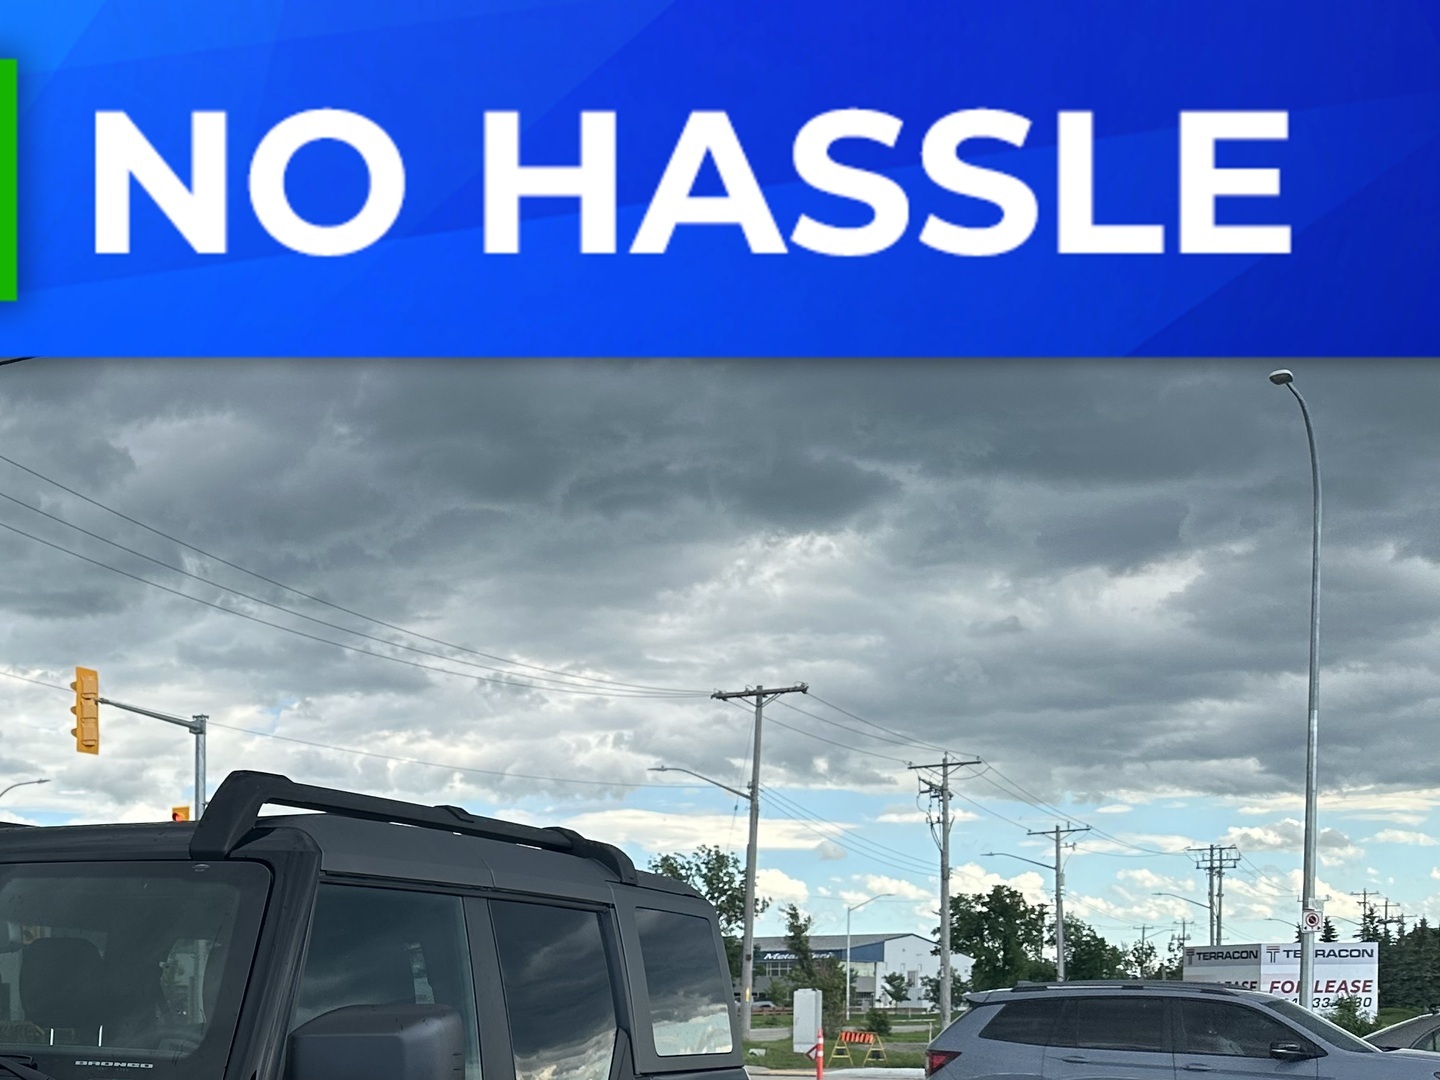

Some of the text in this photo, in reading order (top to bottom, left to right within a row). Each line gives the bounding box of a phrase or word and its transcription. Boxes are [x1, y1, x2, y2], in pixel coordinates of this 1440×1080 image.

[1196, 950, 1259, 961] TERRACON
[1283, 949, 1374, 958] TERACON
[1314, 979, 1373, 994] LEASE
[75, 1060, 154, 1069] BRONCO
